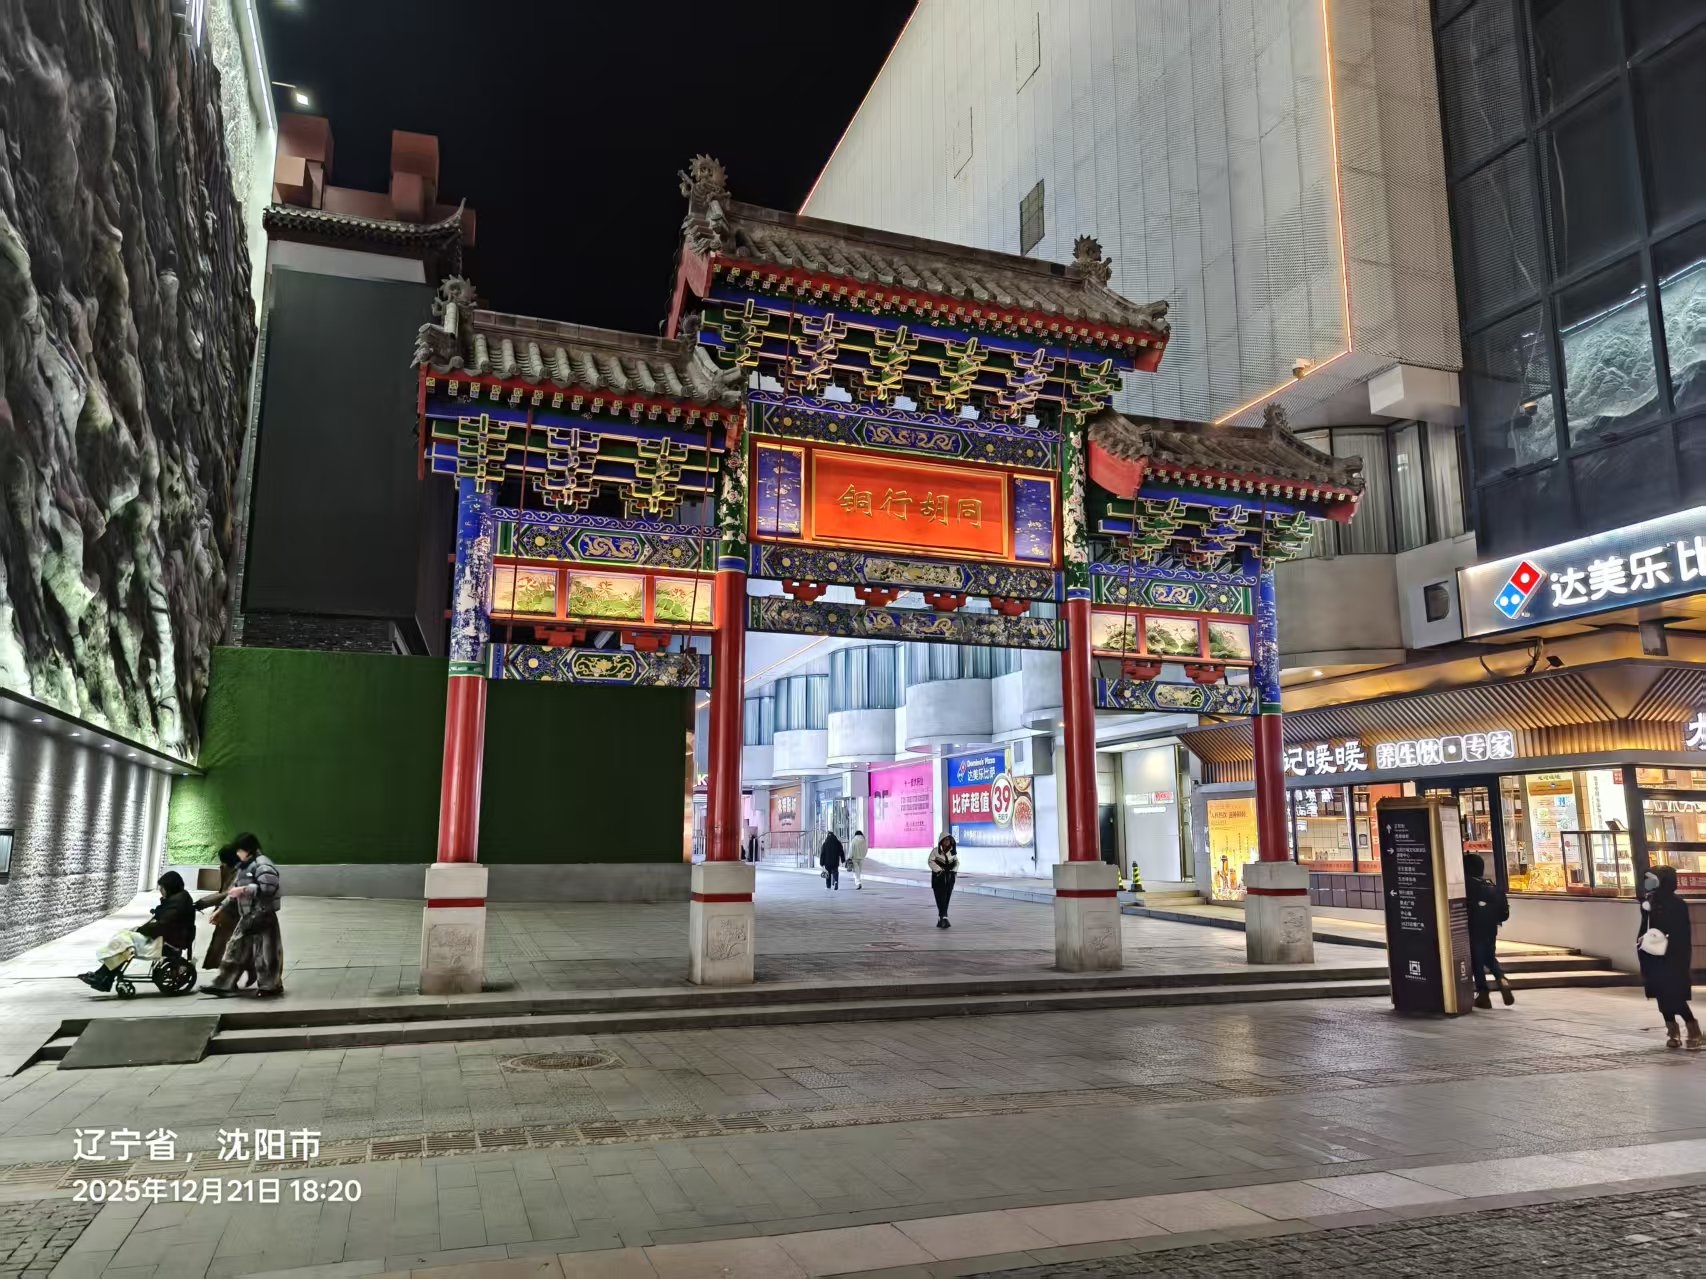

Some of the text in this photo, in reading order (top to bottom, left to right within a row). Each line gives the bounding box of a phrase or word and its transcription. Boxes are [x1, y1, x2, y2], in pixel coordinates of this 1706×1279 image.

[967, 766, 996, 781] 达美乐比萨
[952, 790, 990, 815] 比萨超值
[994, 785, 1012, 813] 39
